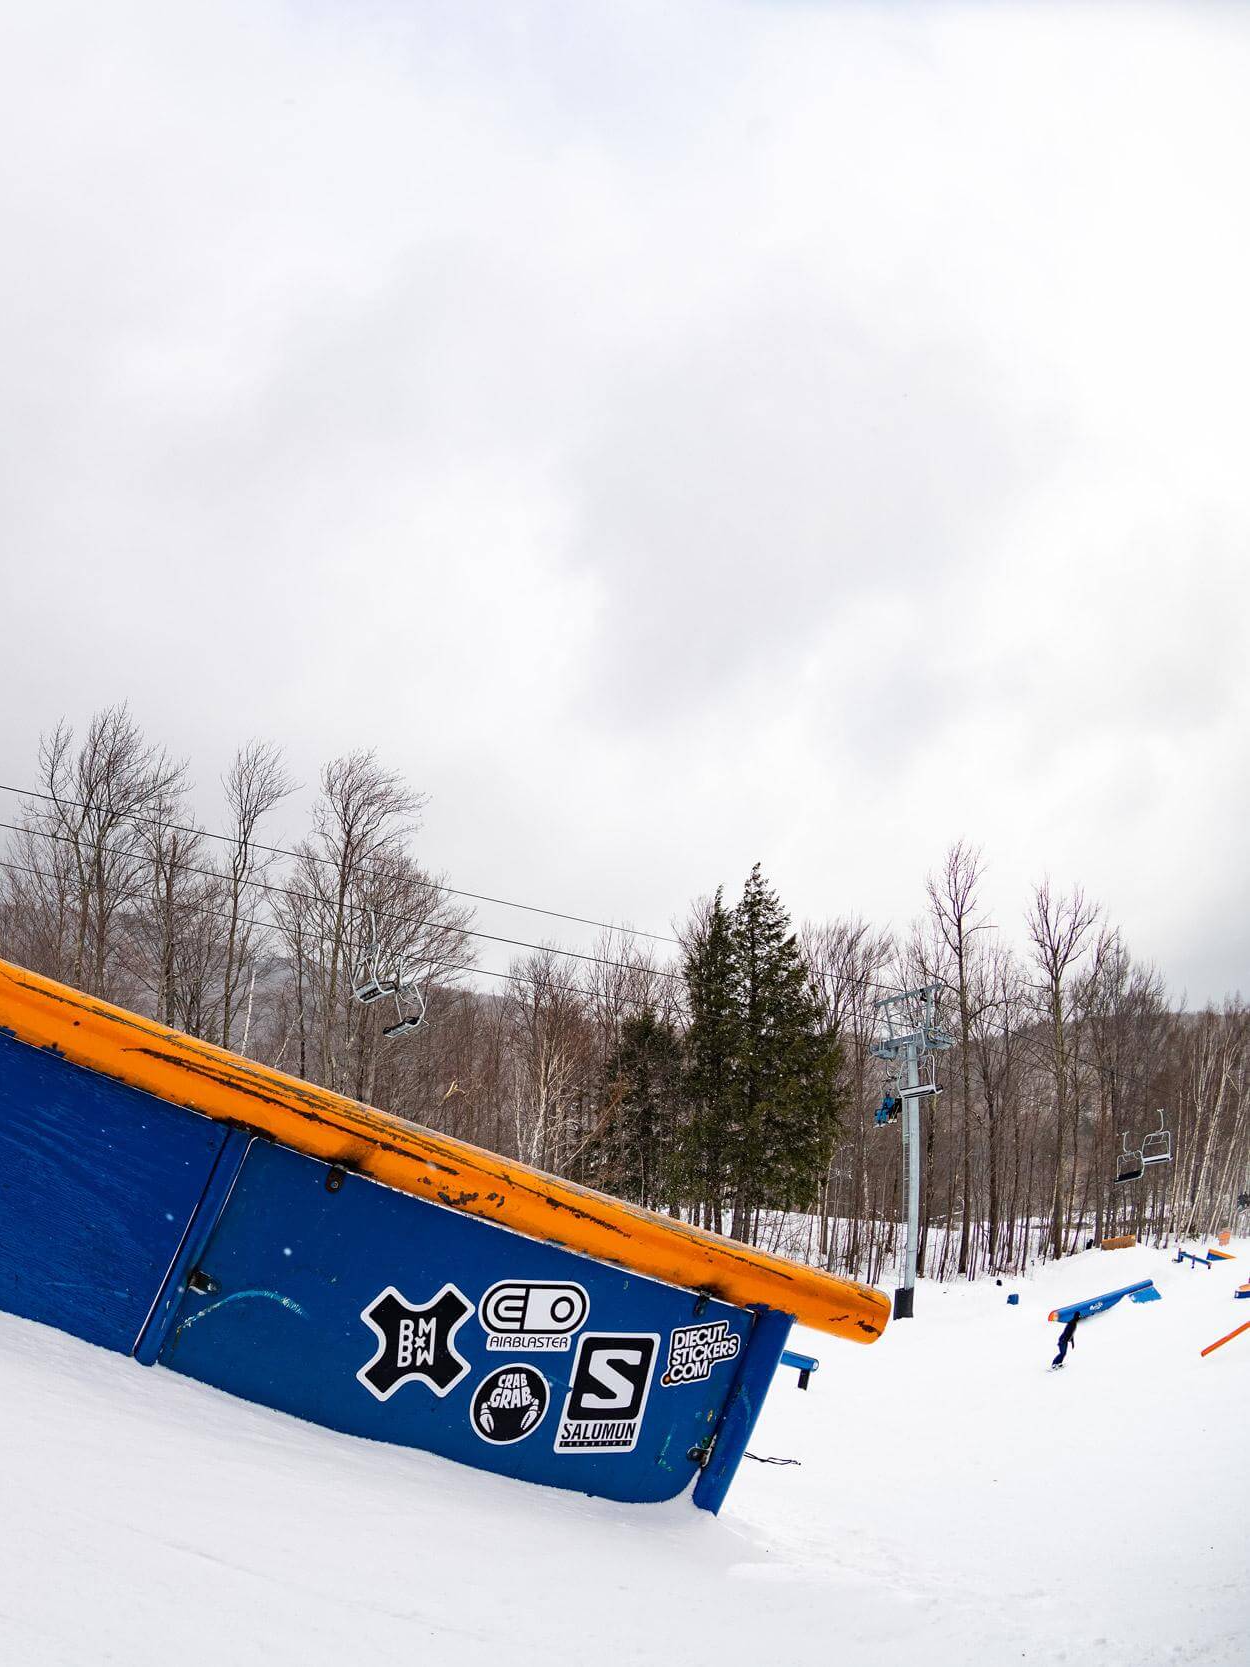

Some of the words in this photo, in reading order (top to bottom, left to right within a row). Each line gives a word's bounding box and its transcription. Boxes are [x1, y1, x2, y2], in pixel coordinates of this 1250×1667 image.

[489, 1335, 568, 1348] AIRBLASTER
[673, 1325, 725, 1349] DIECUT
[671, 1338, 737, 1365] STICKERS
[498, 1373, 528, 1388] CRAB
[490, 1386, 532, 1409] GRAB
[561, 1422, 637, 1440] SALOMON
